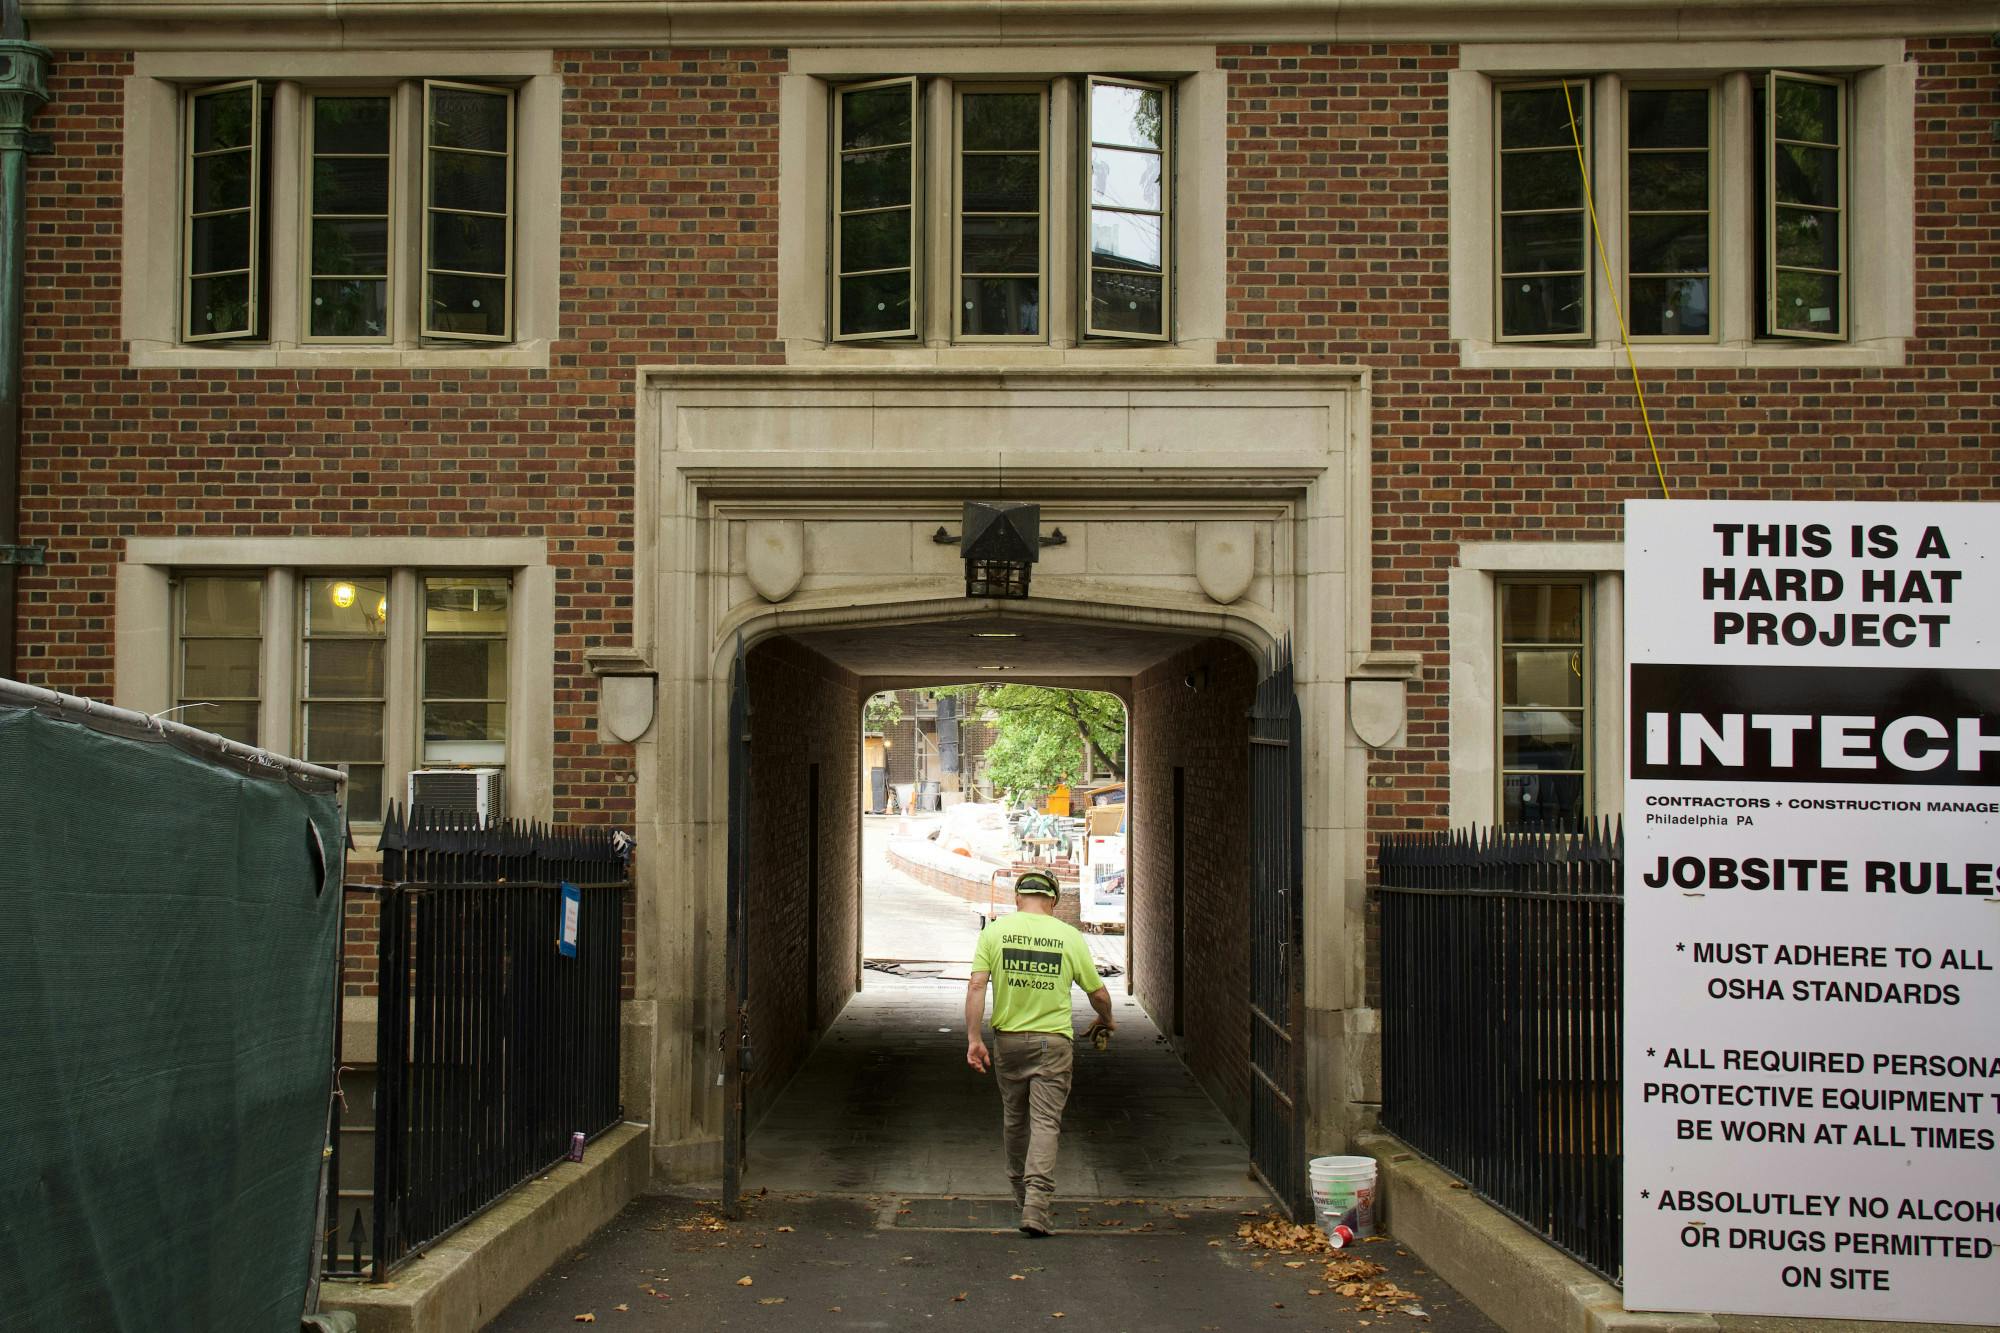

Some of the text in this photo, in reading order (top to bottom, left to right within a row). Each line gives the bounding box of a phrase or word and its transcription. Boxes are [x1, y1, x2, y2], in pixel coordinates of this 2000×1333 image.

[1713, 524, 1950, 558] THIS IS A
[1703, 568, 1962, 603] HARD HAT
[1714, 612, 1950, 647] PROJECT
[1645, 796, 1770, 808] CONTRACTORS
[1788, 799, 1921, 811] CONSTRUCTION
[1646, 813, 1754, 828] Philadelphia PA
[1644, 856, 2000, 896] JOBSITE RULE
[1002, 934, 1064, 949] SAFETY MONTH
[1694, 942, 1993, 971] MUST ADHERE TO ALL
[1004, 959, 1059, 974] INTECH
[1707, 978, 1961, 1005] OSHA STANDARDS
[1663, 1048, 1715, 1069] ALL
[1723, 1050, 1864, 1073] REQUIRED
[1643, 1083, 1813, 1108] PROTECTIVE
[1822, 1087, 1984, 1114] EQUIPMENT
[1677, 1119, 1995, 1151] BE WORN AT ALL TIMES
[1658, 1190, 2000, 1222] ABSOLUTLEY NO ALCOH
[1681, 1226, 1993, 1259] OR DRUGS PERMITTED
[1781, 1266, 1890, 1291] ON SITE
